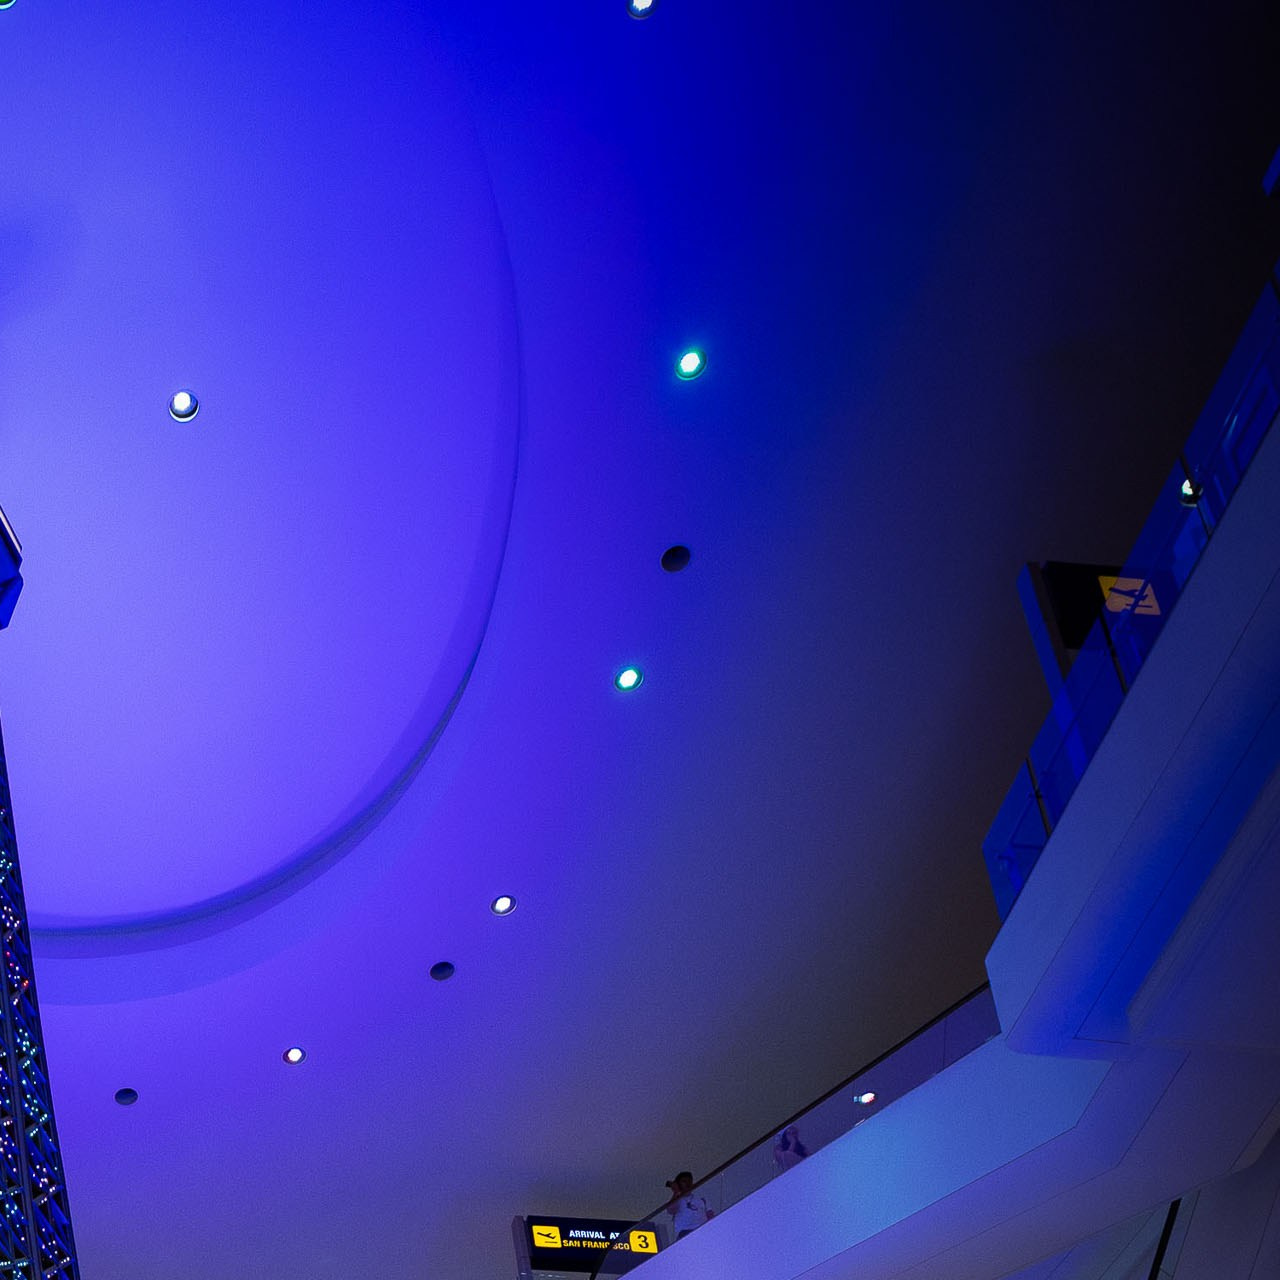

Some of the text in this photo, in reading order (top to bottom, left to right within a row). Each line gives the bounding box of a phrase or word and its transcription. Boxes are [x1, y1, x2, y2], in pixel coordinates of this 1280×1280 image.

[569, 1230, 621, 1240] ARRIVAL AT
[562, 1239, 630, 1251] SAN FRANCSCO
[637, 1234, 650, 1249] 3
